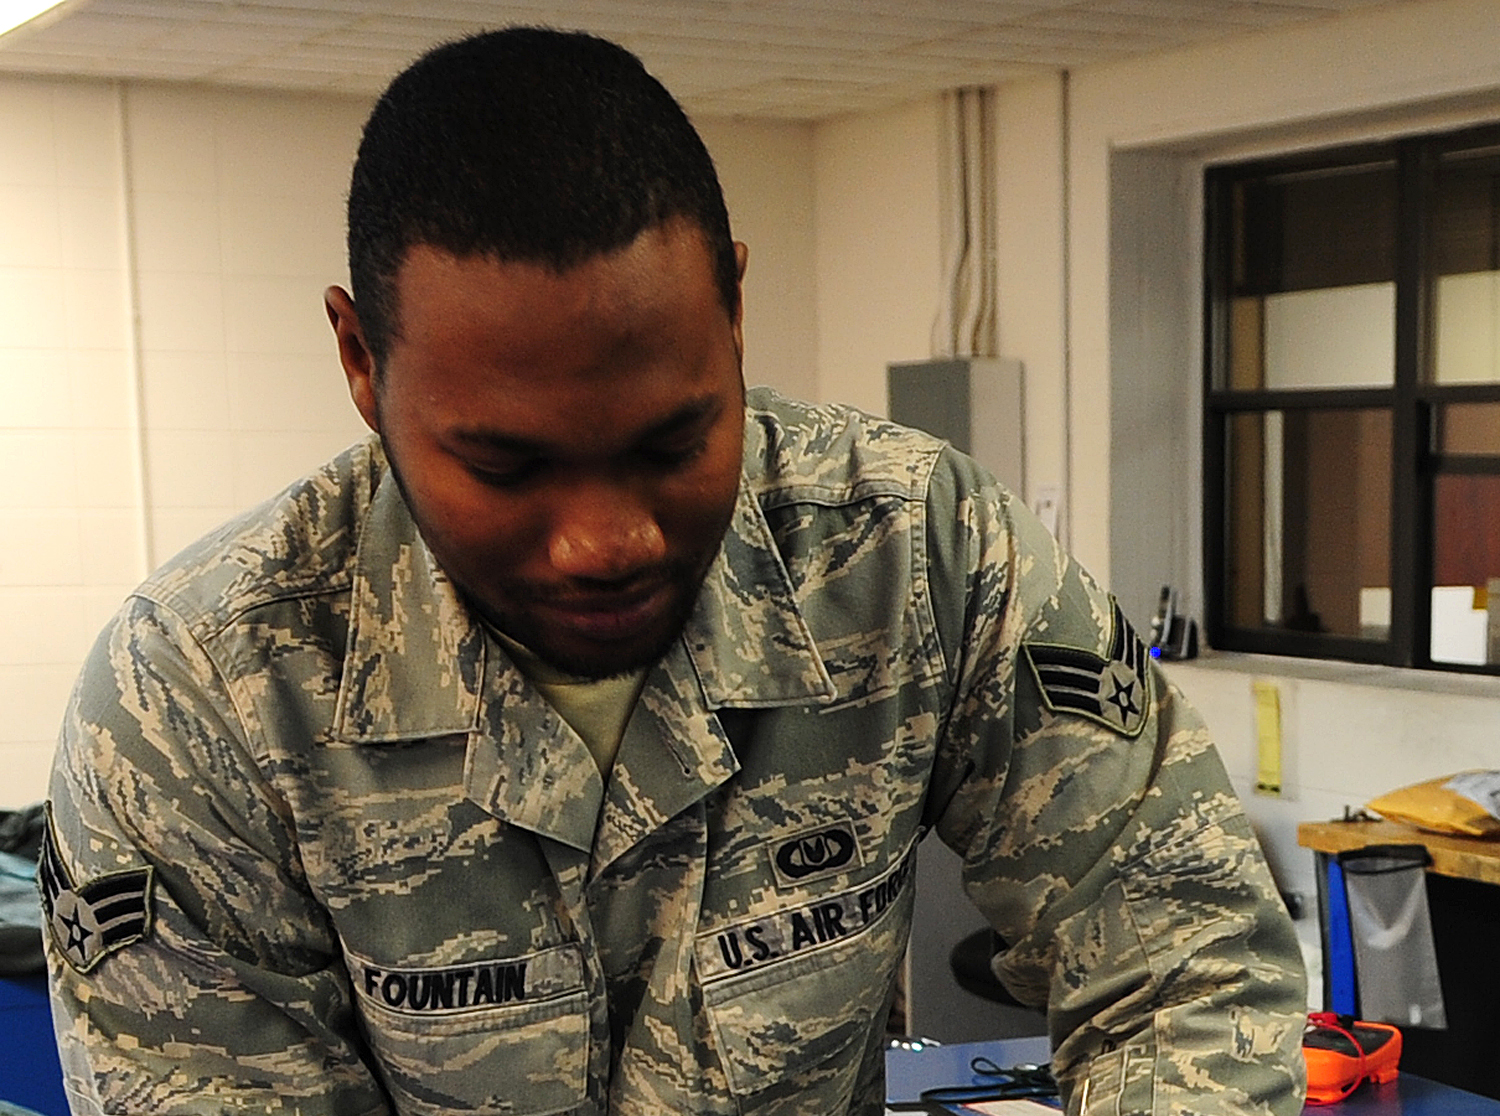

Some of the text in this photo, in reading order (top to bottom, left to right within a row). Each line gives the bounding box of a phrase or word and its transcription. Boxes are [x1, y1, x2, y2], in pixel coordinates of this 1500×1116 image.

[717, 856, 910, 970] U.S. AIR FORC
[364, 962, 528, 1012] FOUNTAIN
